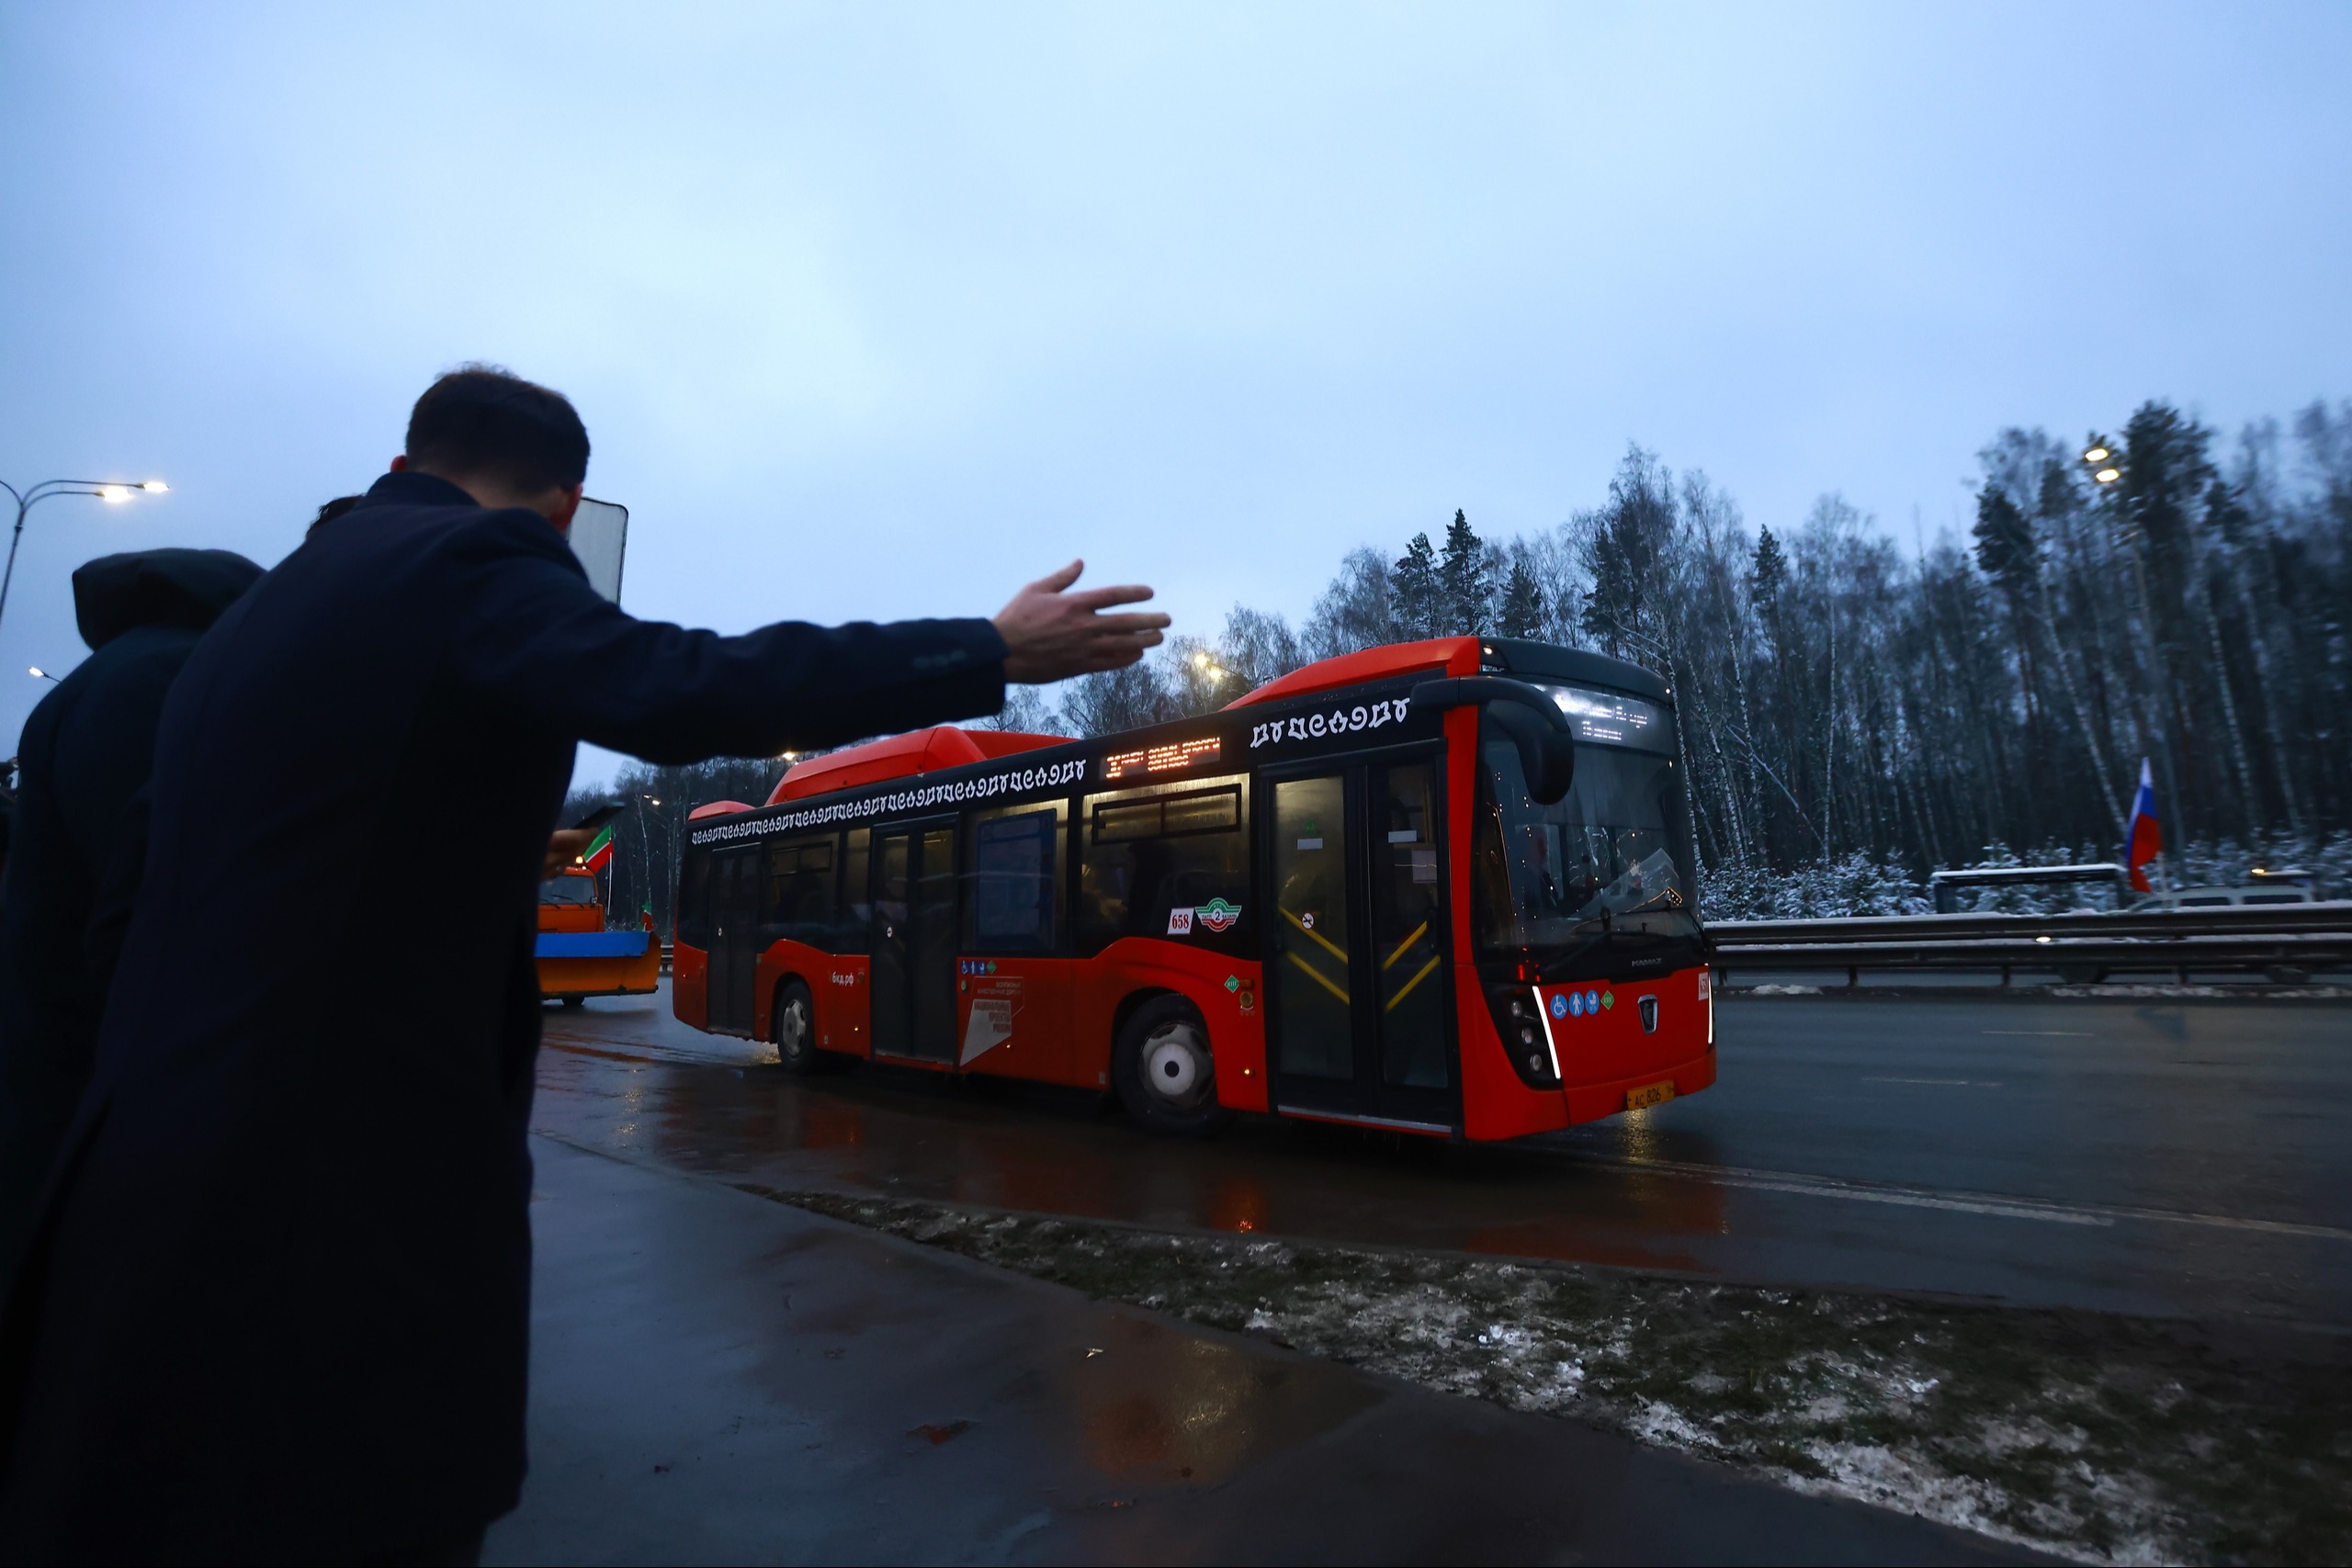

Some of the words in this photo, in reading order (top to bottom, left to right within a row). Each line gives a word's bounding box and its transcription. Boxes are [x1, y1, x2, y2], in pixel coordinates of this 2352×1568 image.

[1172, 914, 1189, 929] 658
[1215, 911, 1220, 920] 2
[832, 971, 854, 987] бкд.рф
[1646, 1088, 1661, 1104] 826
